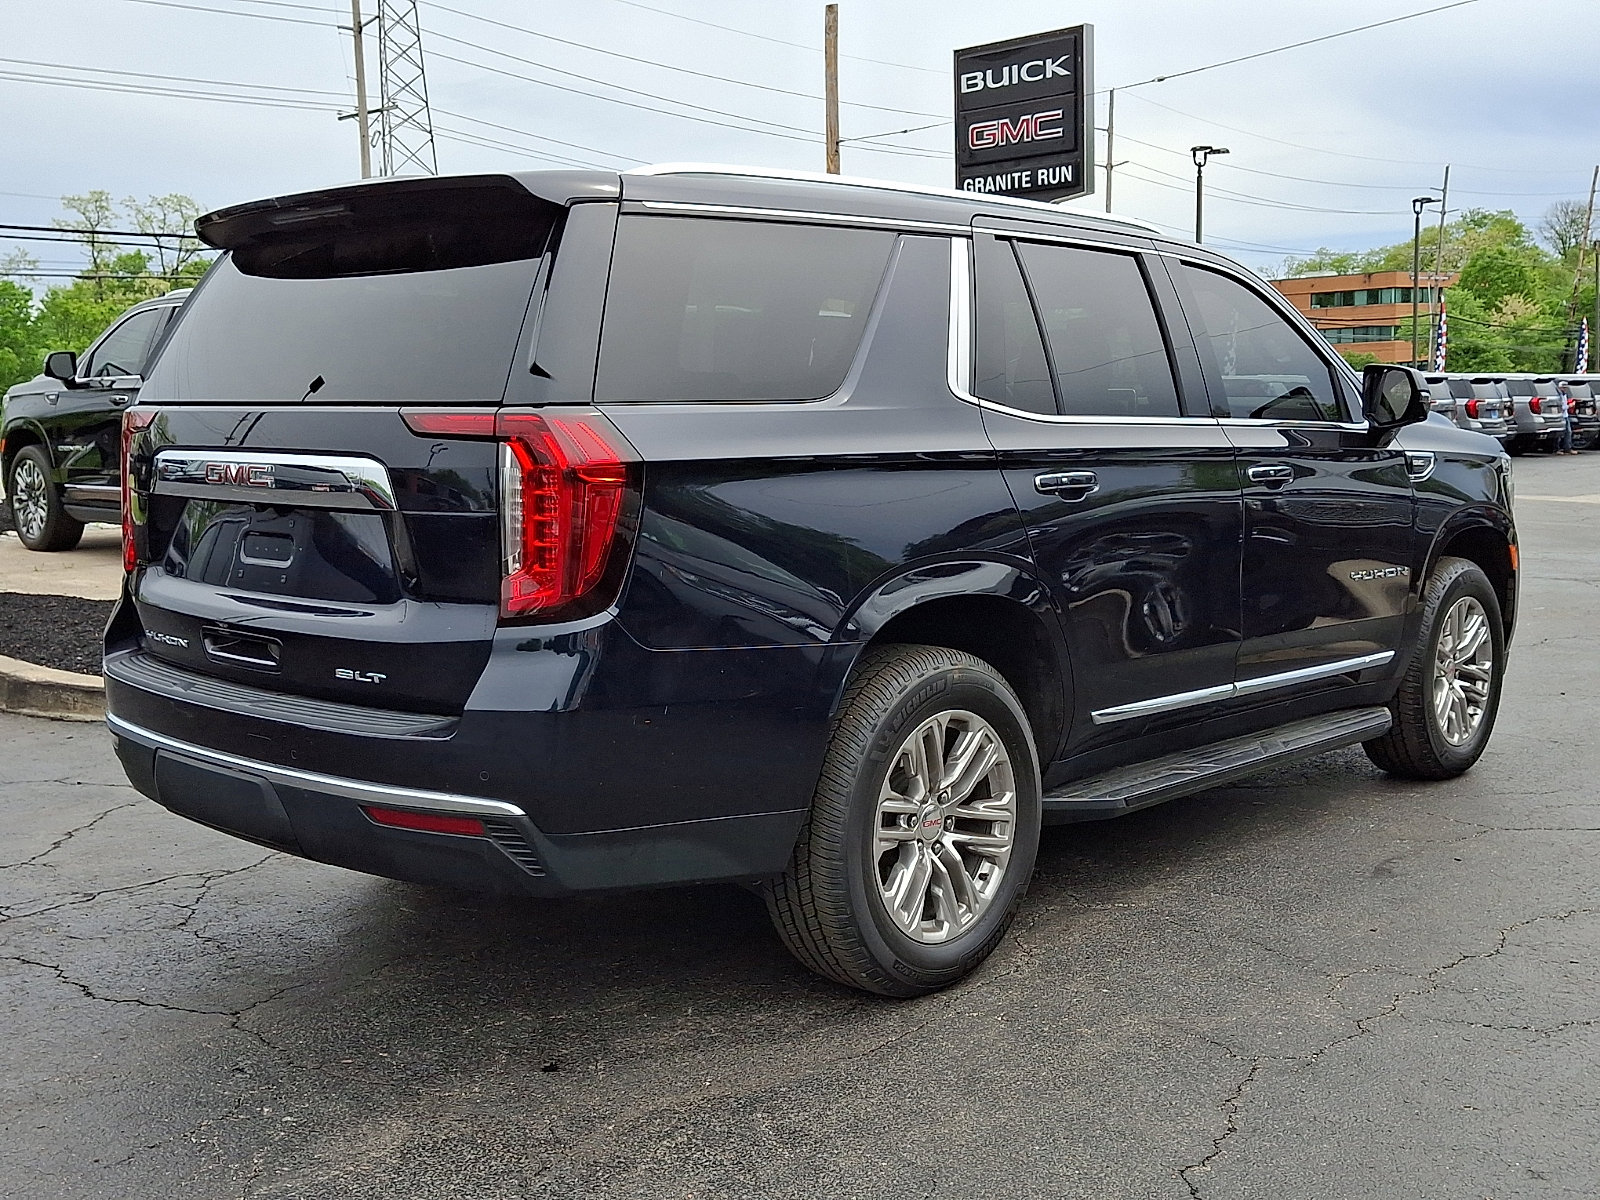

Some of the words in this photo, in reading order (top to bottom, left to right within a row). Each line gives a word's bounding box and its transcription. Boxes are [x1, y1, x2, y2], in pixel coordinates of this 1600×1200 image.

[960, 54, 1072, 93] BUICK
[968, 109, 1064, 150] GMC
[963, 170, 1032, 193] GRANITE
[1037, 164, 1073, 186] RUN
[205, 461, 276, 489] GMC
[1350, 566, 1410, 581] YUKON
[145, 629, 190, 648] YUKON
[335, 668, 387, 684] SLT
[922, 817, 943, 828] GMC
